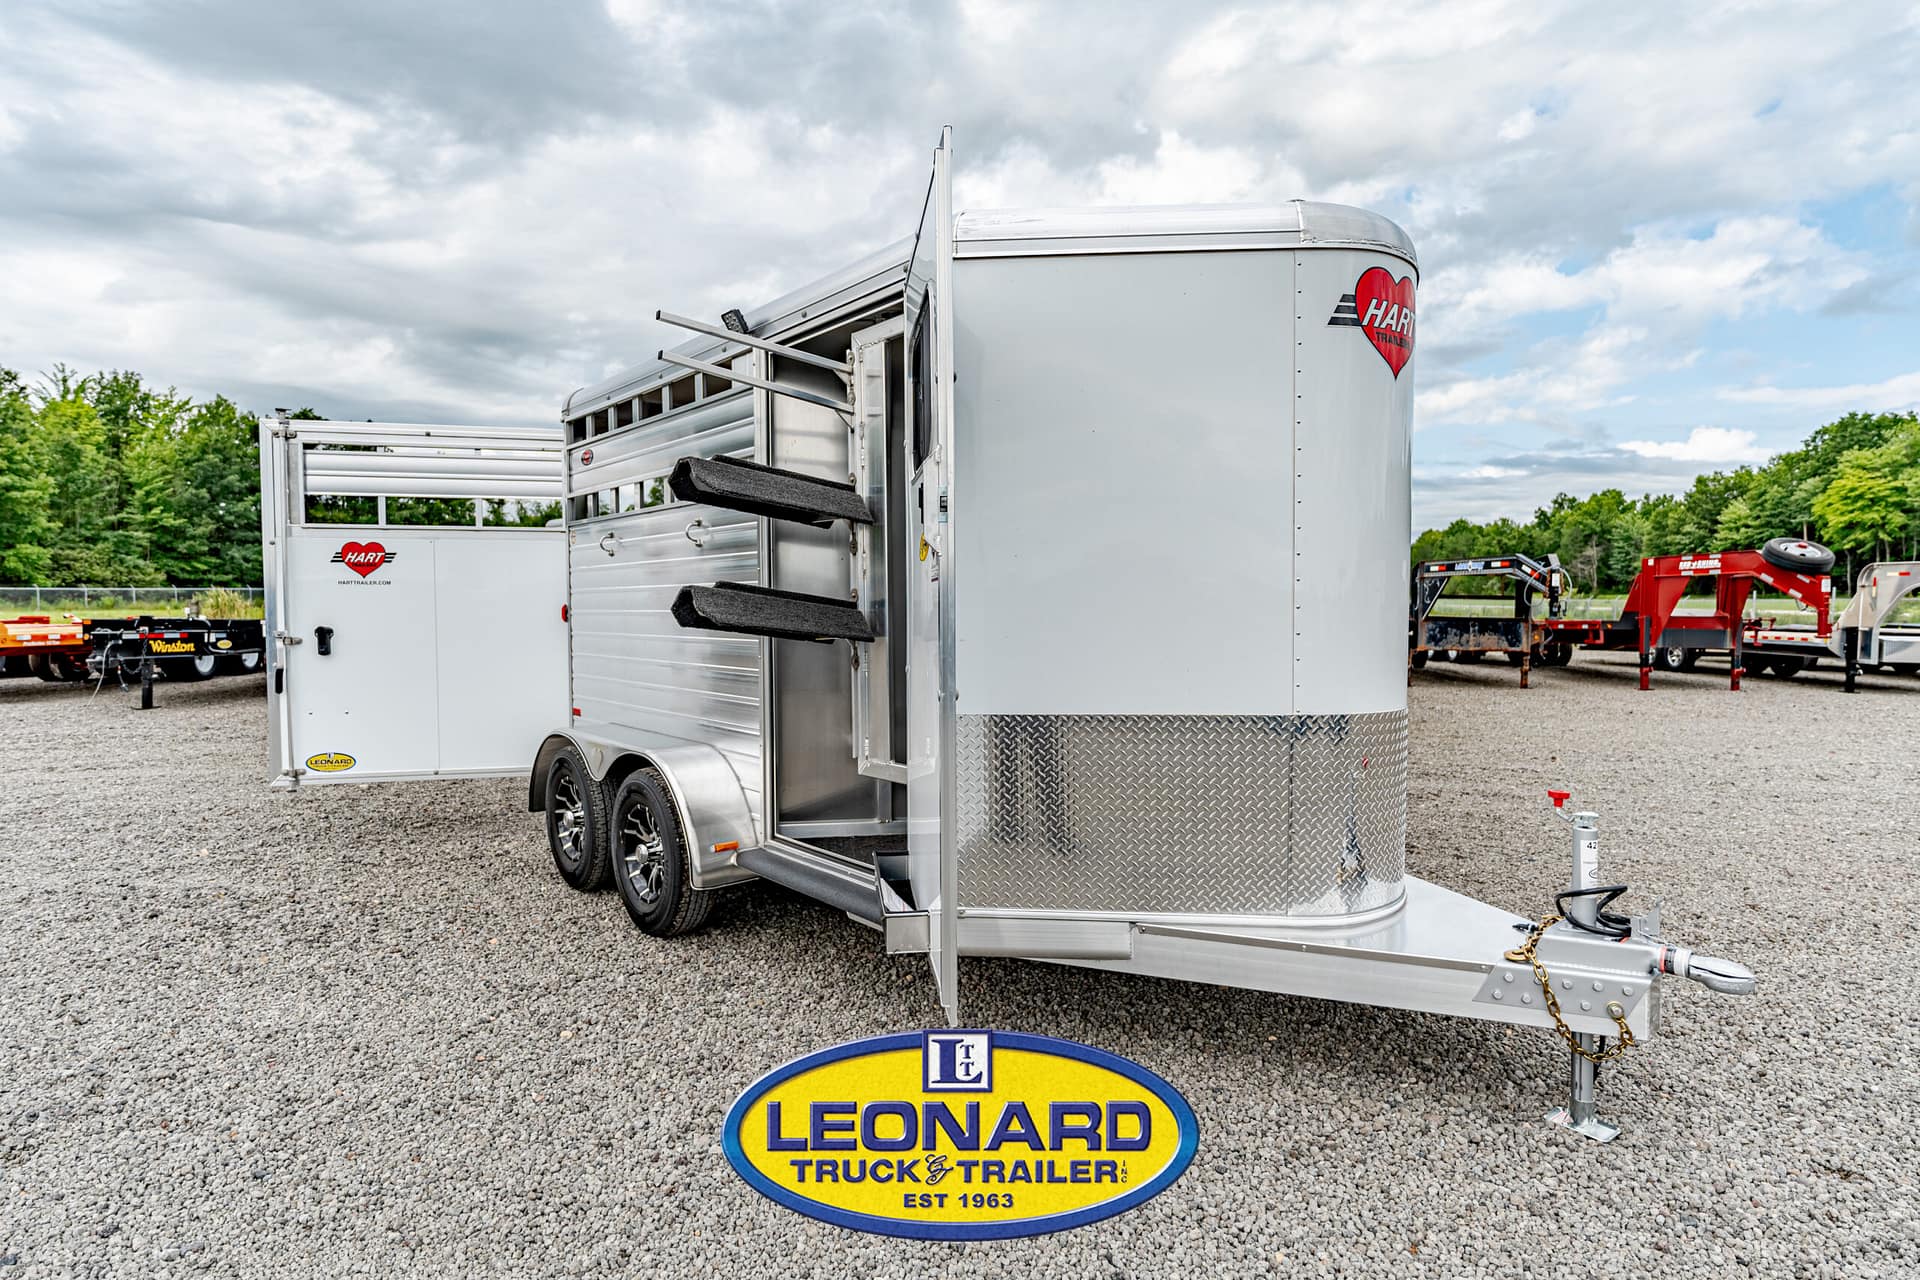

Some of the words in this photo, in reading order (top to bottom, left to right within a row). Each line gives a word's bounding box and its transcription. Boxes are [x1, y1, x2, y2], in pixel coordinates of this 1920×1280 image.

[1361, 298, 1415, 337] HART
[344, 551, 385, 563] HART
[149, 640, 196, 653] Winston
